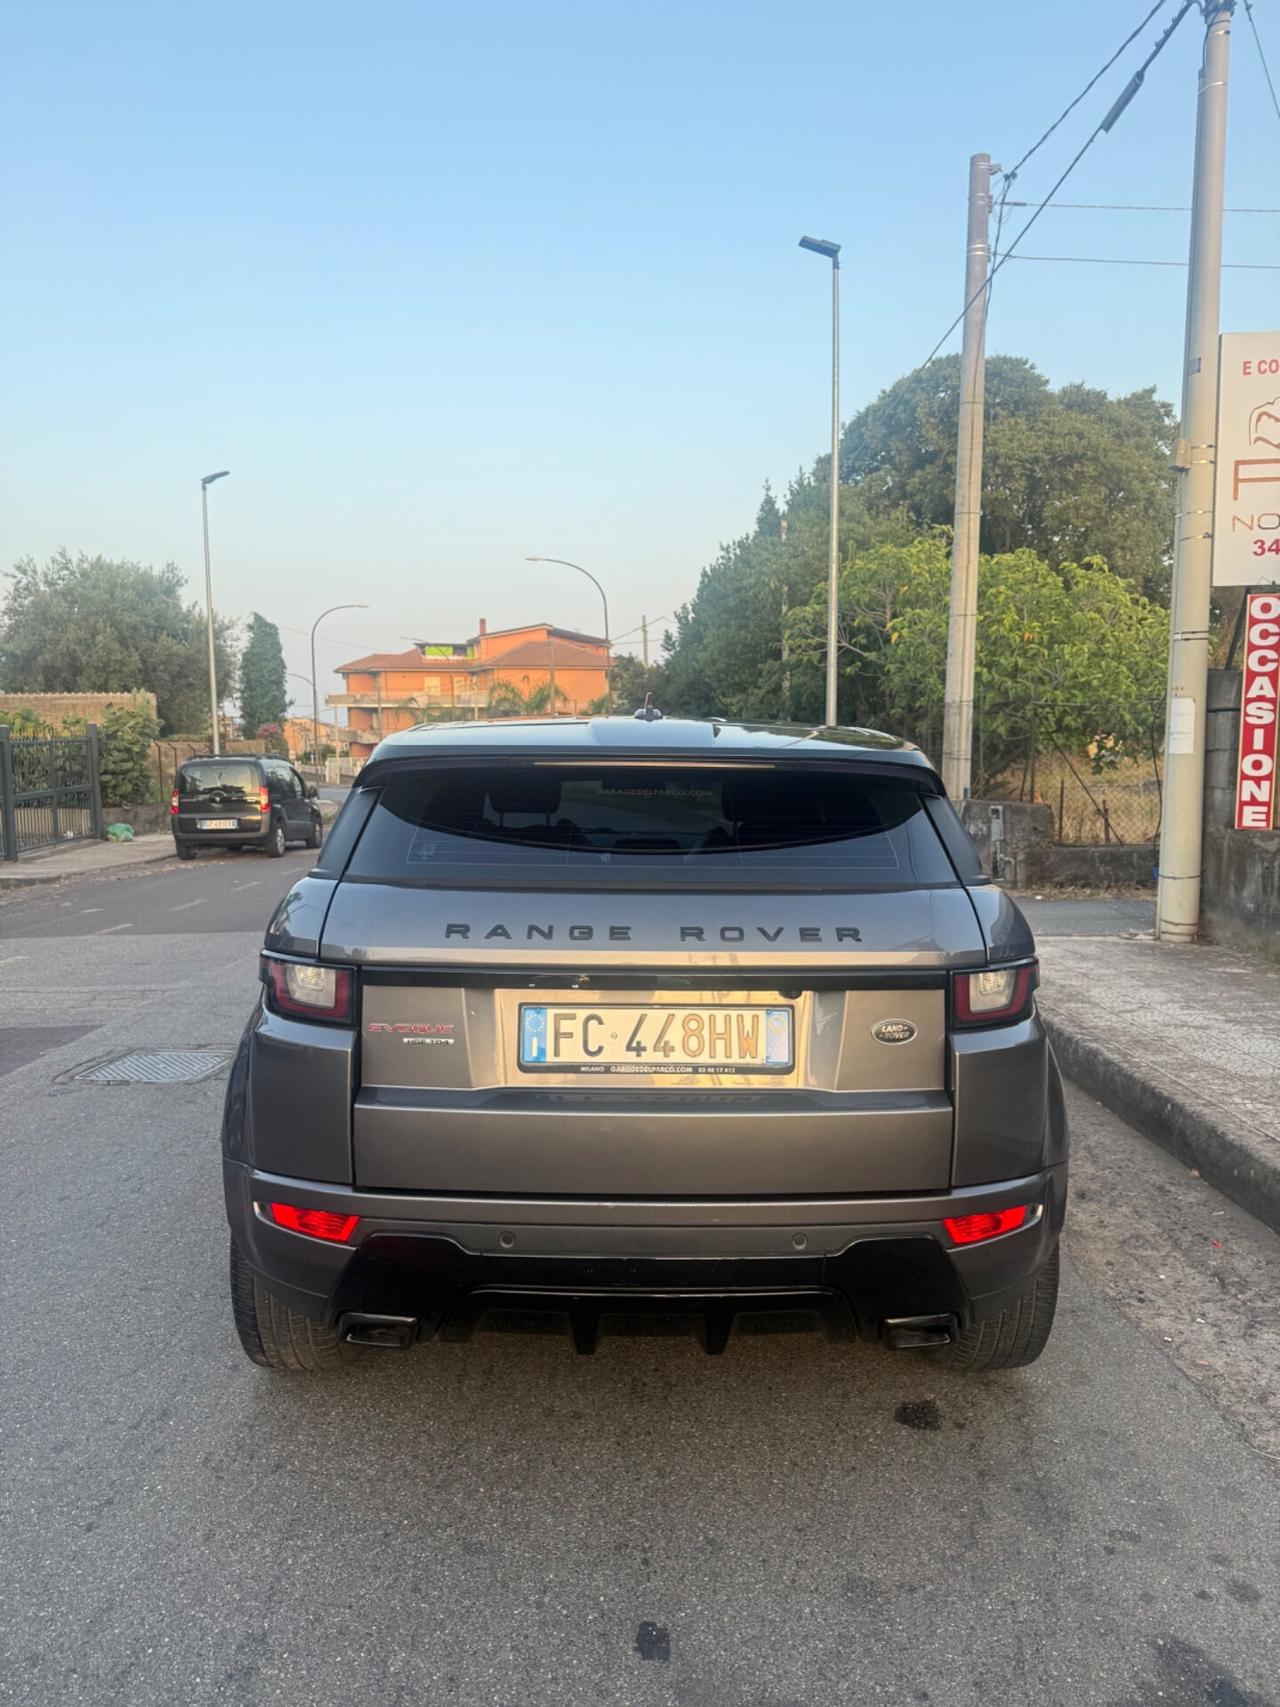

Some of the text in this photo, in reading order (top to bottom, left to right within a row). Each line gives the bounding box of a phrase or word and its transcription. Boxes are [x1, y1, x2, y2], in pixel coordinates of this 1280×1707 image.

[1241, 596, 1280, 827] OCCASIONE
[445, 923, 863, 943] RANGE ROVER
[553, 1013, 604, 1058] FC
[625, 1013, 760, 1059] 448HW
[881, 1024, 904, 1033] LAND
[884, 1031, 910, 1040] ROVER
